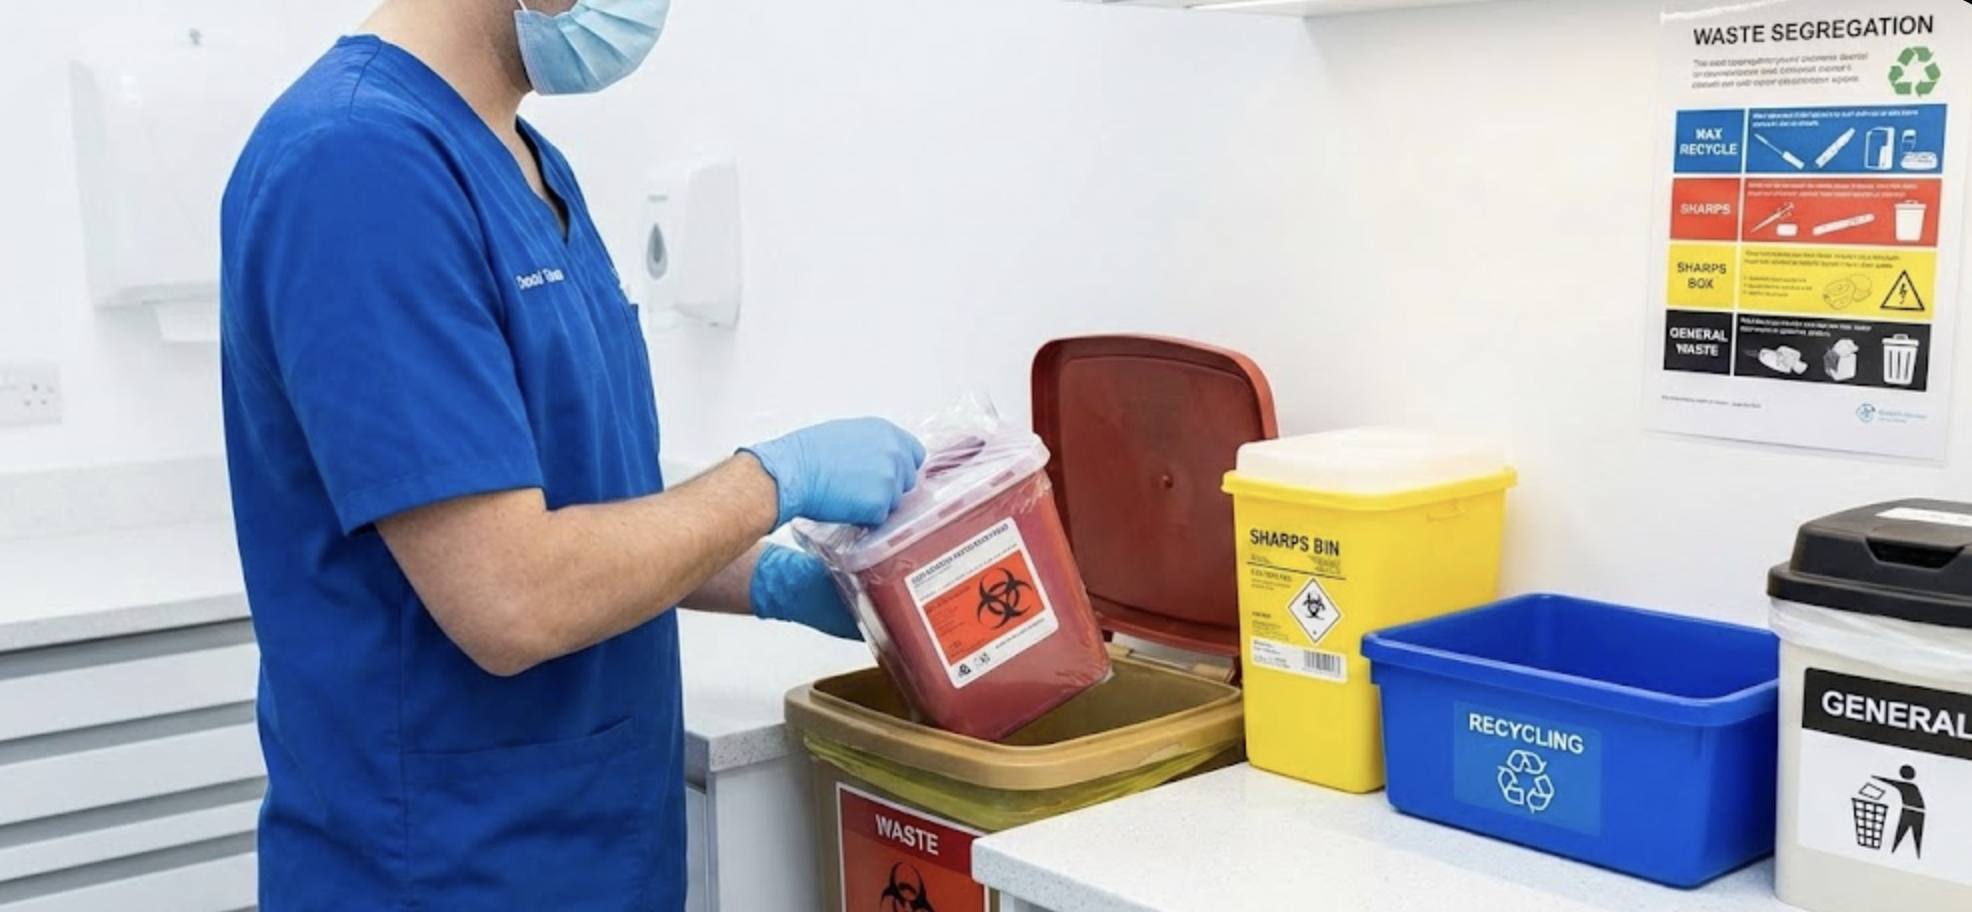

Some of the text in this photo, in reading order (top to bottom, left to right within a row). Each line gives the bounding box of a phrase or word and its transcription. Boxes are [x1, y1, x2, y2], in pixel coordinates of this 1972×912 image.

[1694, 15, 1934, 46] WASTE SEGREGATION
[1679, 143, 1738, 156] RECYCLE
[1679, 203, 1731, 216] SHARPS
[1677, 262, 1727, 275] SHARPS
[1687, 278, 1714, 289] BOX
[1669, 327, 1729, 343] GENERAL
[1675, 343, 1719, 357] WASTE
[1249, 528, 1340, 557] SHARPS BIN
[1821, 690, 1972, 741] GENERAL
[1469, 712, 1584, 755] RECYCLING
[875, 814, 940, 856] WASTE
